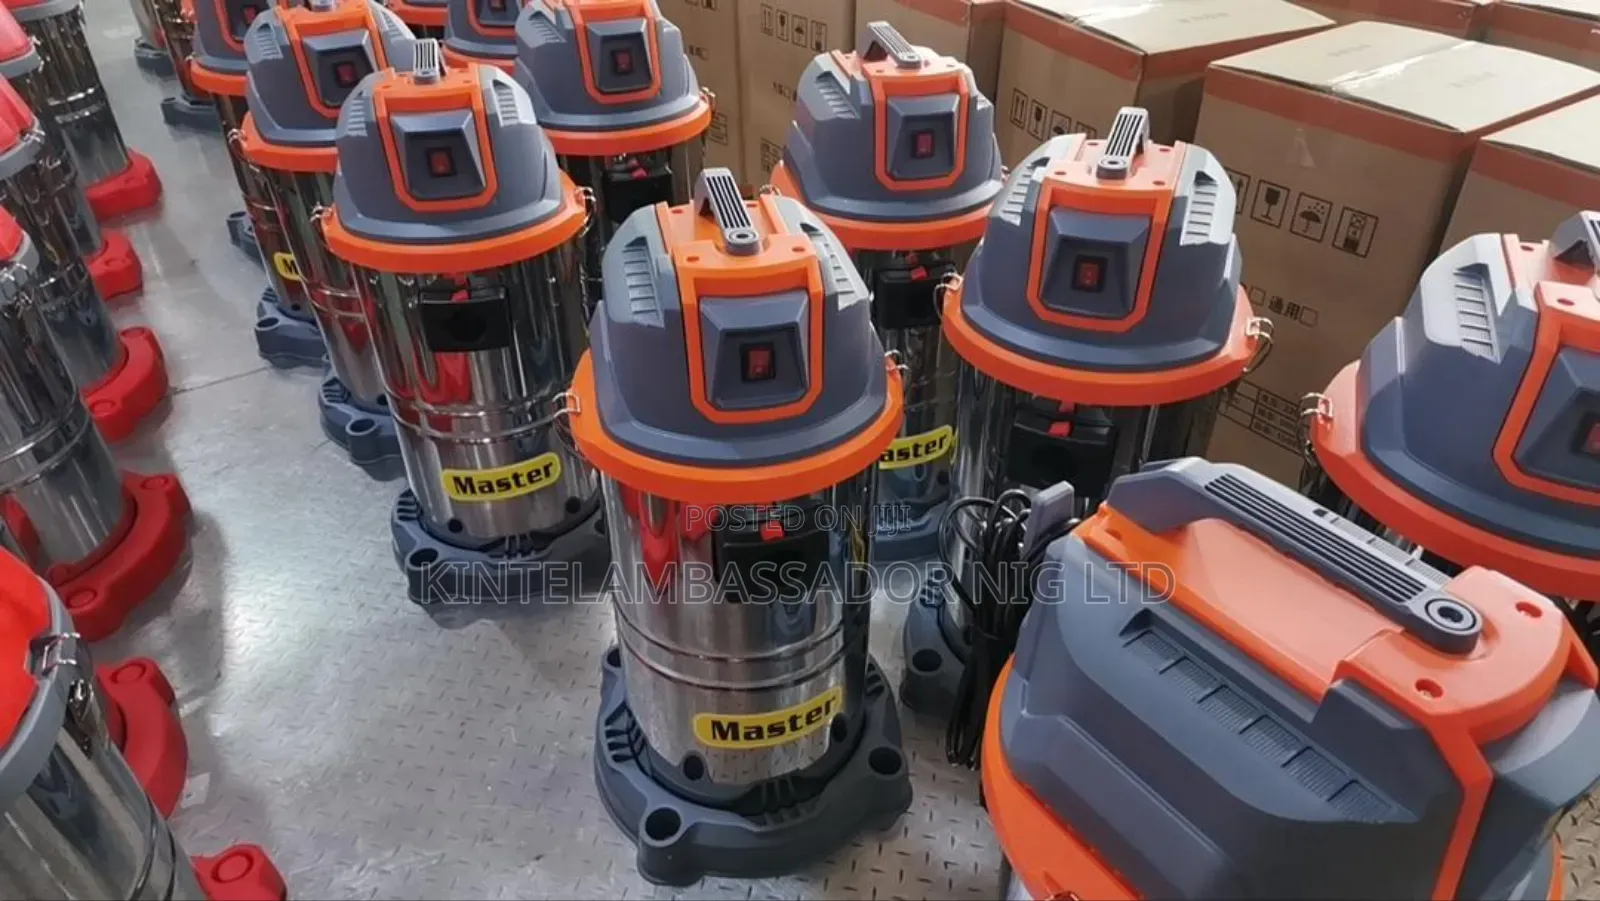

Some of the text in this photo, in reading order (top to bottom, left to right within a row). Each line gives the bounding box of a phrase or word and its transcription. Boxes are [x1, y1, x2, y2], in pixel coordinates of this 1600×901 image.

[879, 433, 948, 462] aster
[453, 461, 554, 497] Master
[710, 695, 837, 742] Master
